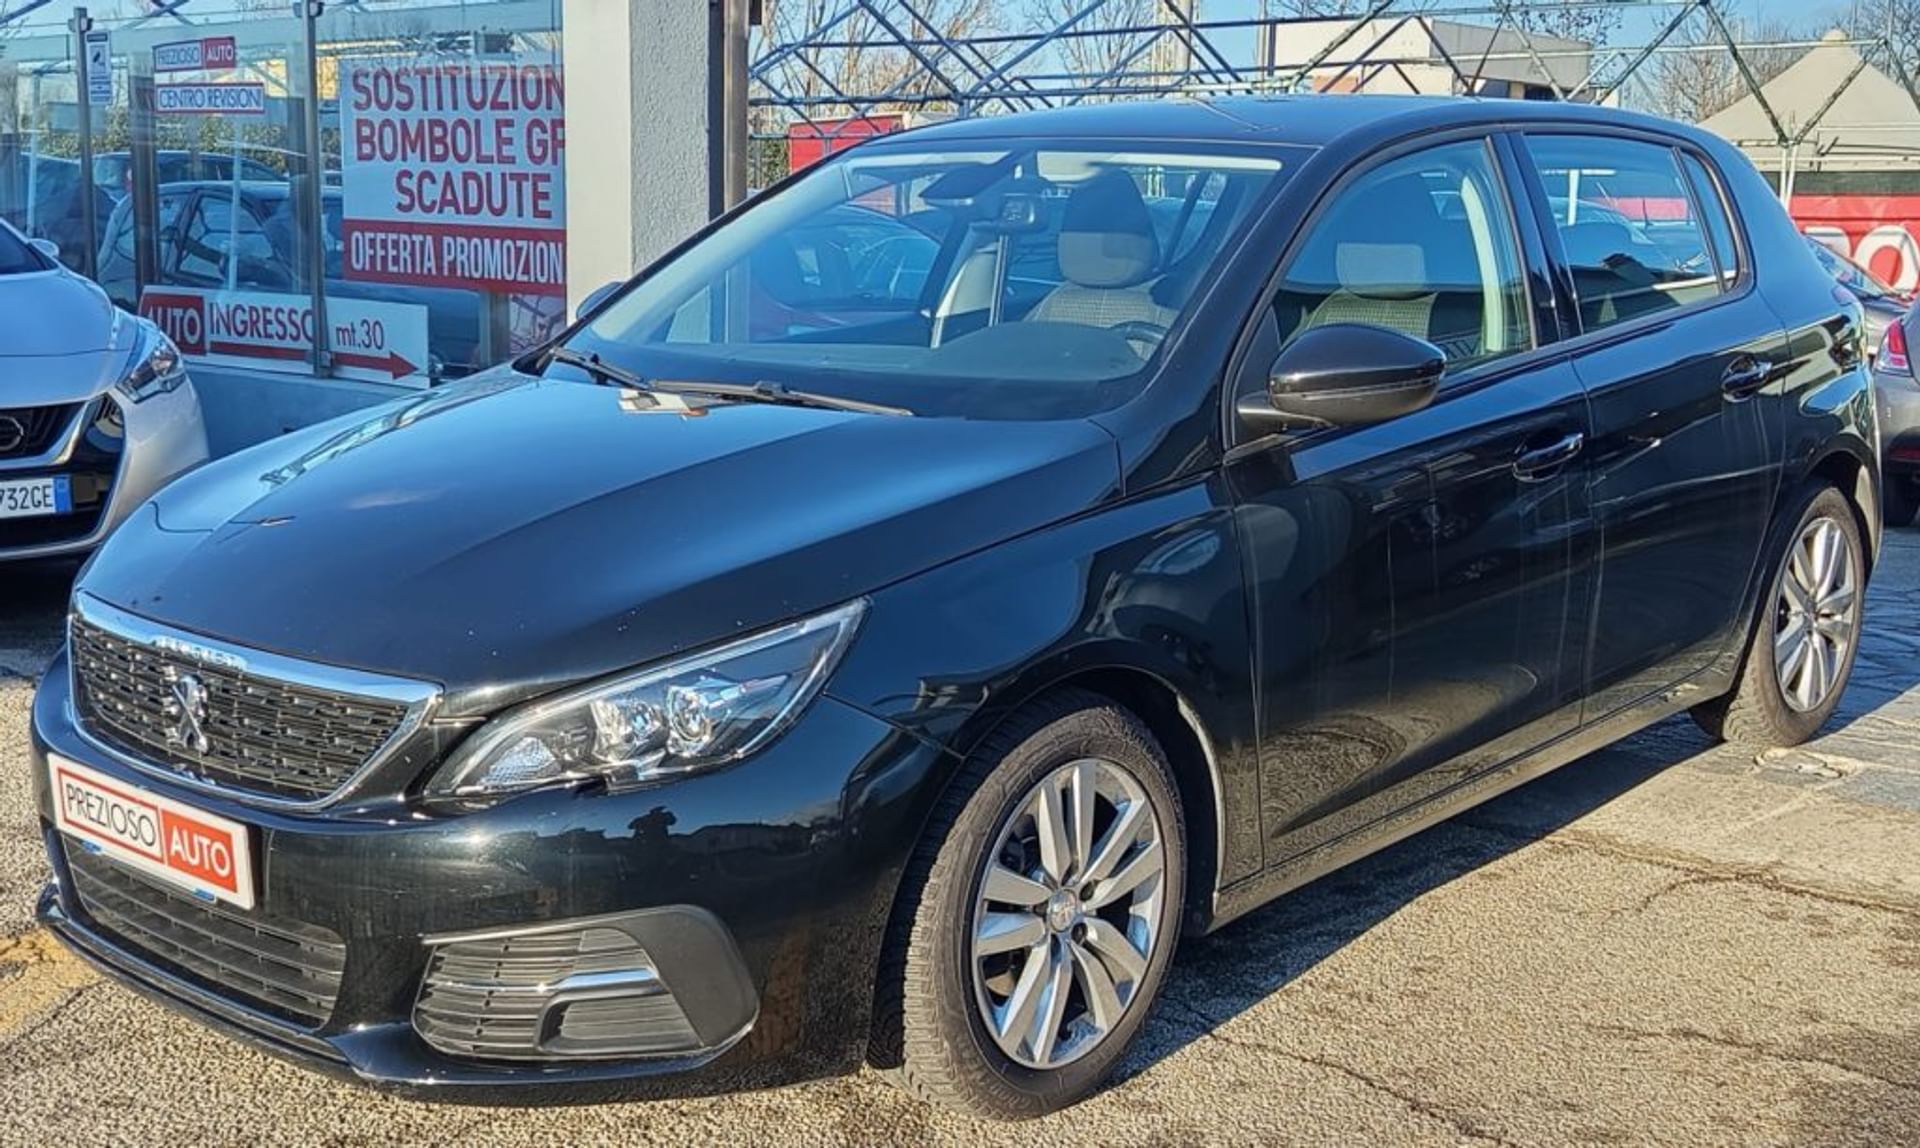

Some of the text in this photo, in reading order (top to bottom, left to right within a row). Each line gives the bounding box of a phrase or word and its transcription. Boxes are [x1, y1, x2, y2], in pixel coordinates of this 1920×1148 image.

[207, 44, 234, 61] AUTO
[159, 88, 205, 108] CENTRO
[352, 64, 565, 111] SOSTITUZION
[356, 118, 516, 165] BOMBOLE
[395, 169, 552, 219] SCADUTE
[351, 231, 564, 284] OFFERTA PROMOZION
[335, 318, 384, 350] mt.30
[65, 783, 231, 878] PREZIOSO AUTO
